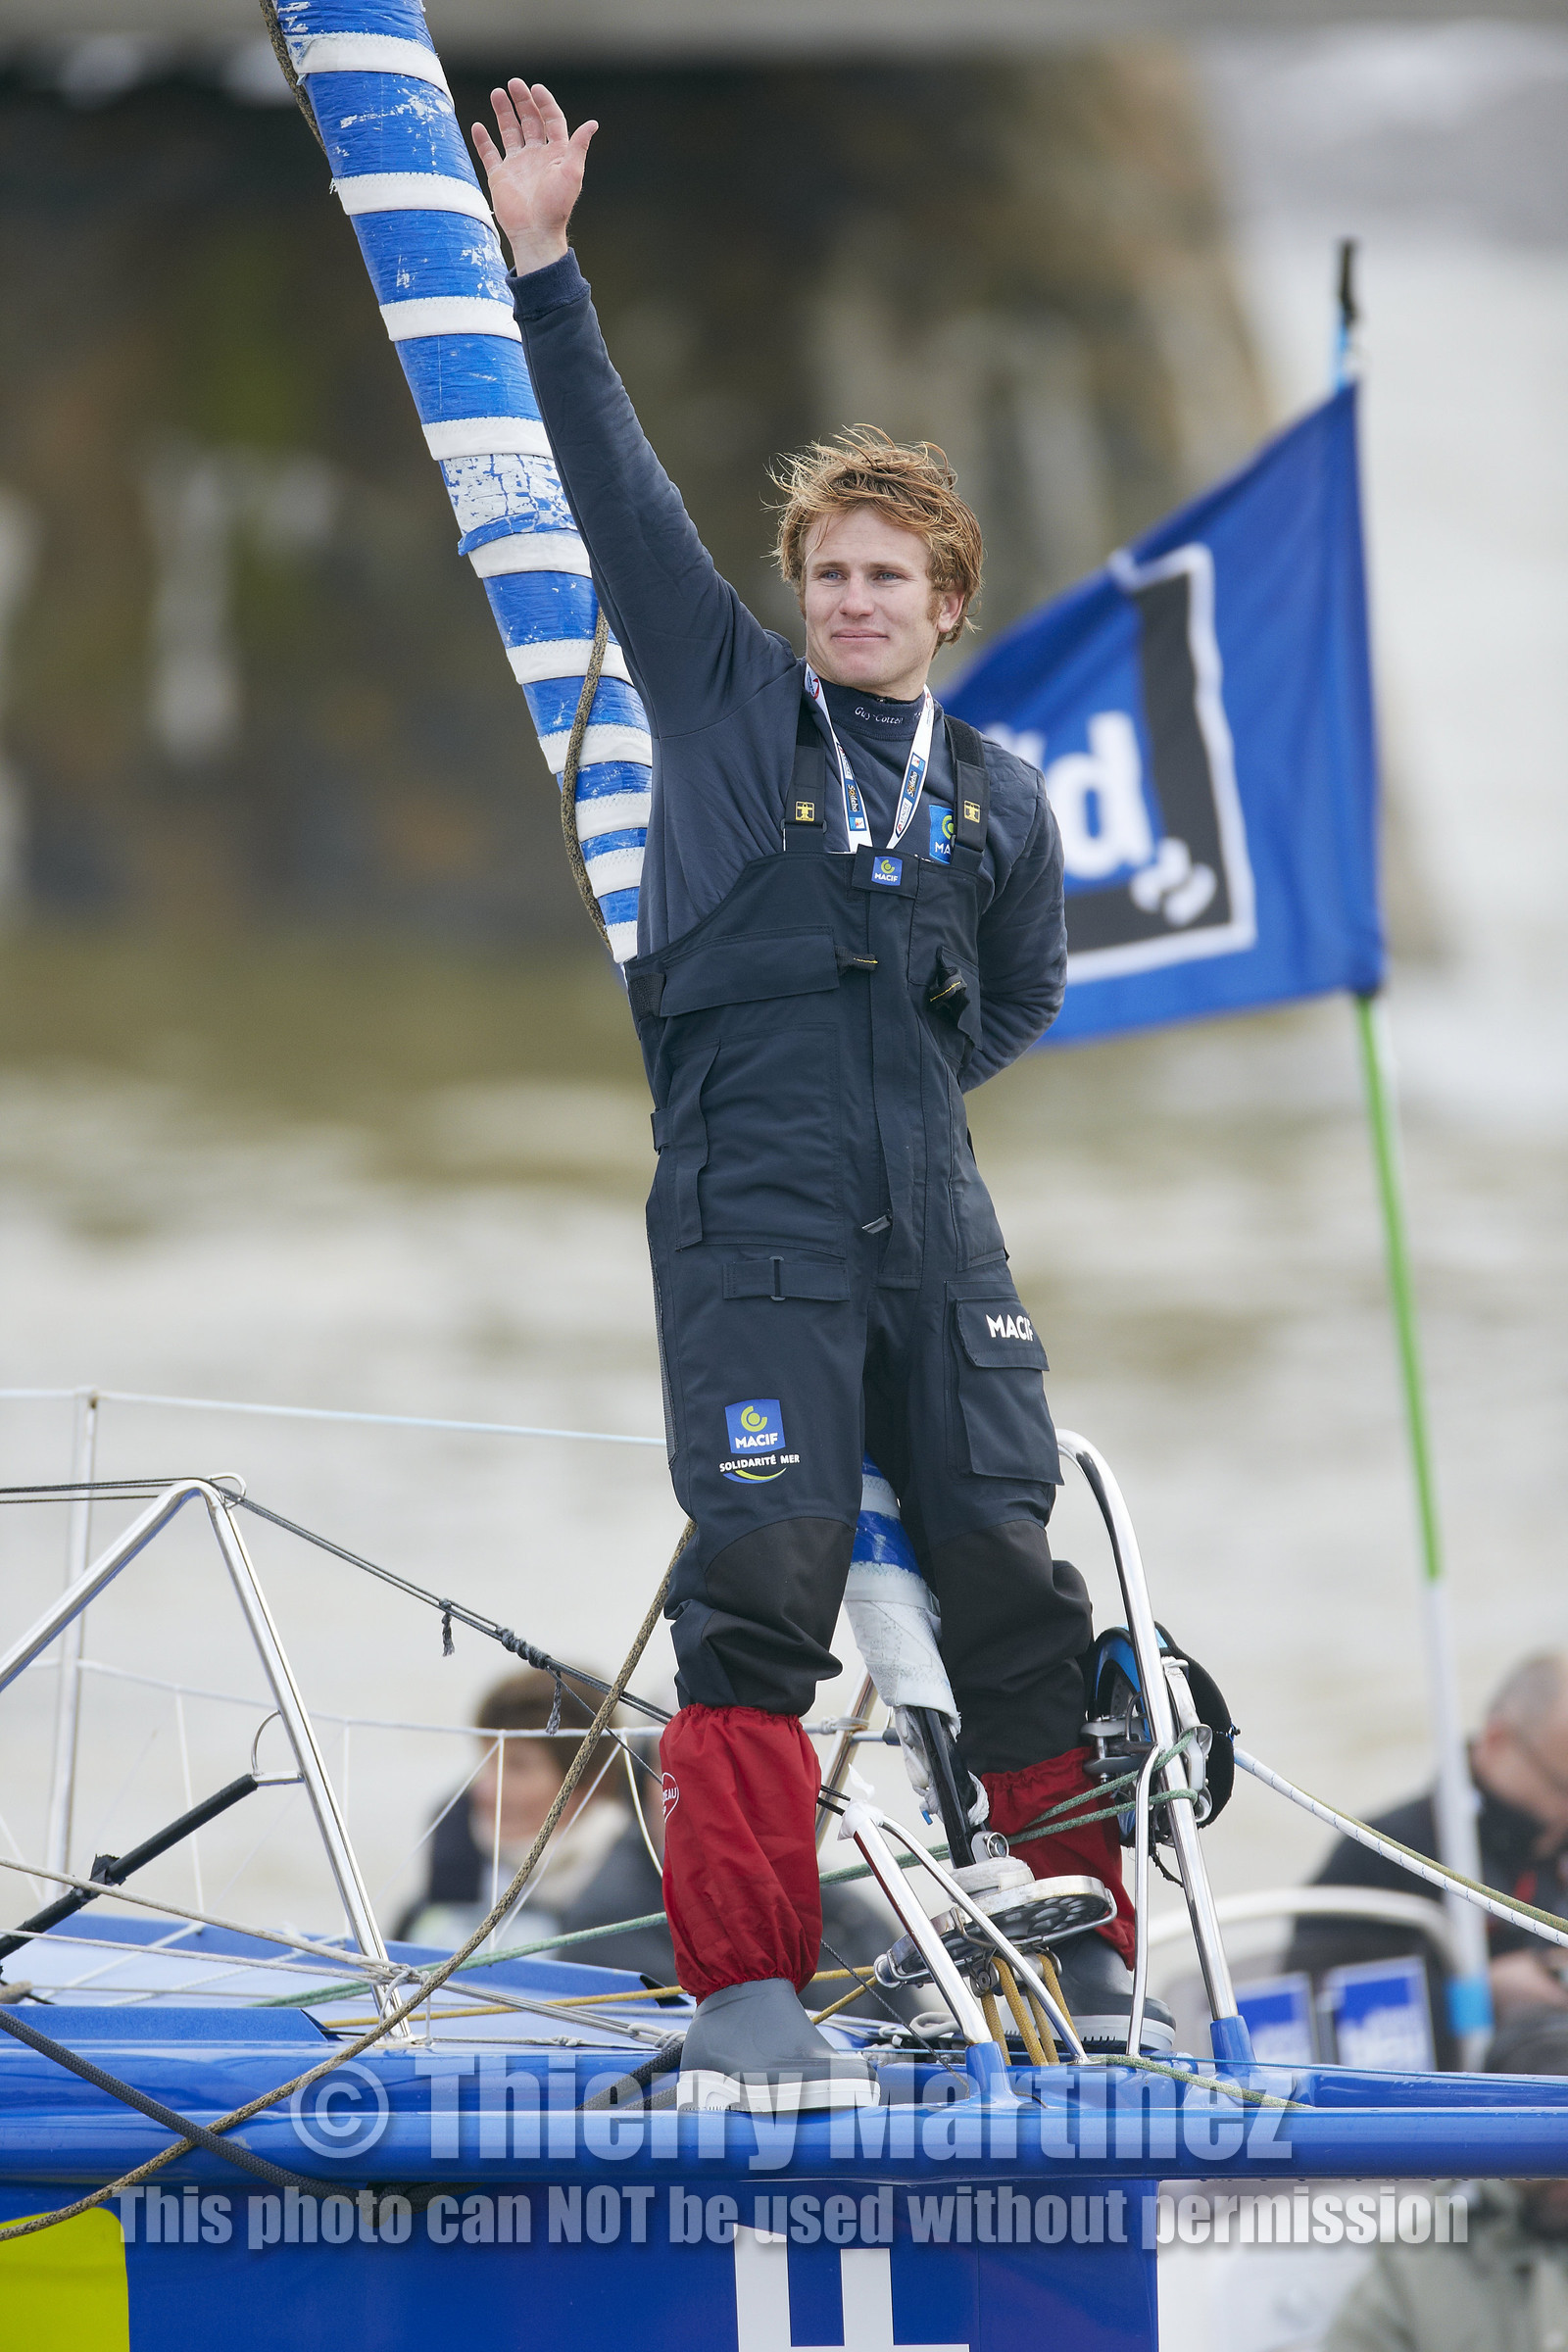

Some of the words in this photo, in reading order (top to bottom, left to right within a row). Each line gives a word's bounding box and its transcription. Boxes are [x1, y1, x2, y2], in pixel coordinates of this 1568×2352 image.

[874, 872, 899, 882] MACIF
[735, 1433, 778, 1448] MACIF
[719, 1454, 777, 1472] SOLIDARITÉ
[780, 1454, 800, 1464] MER
